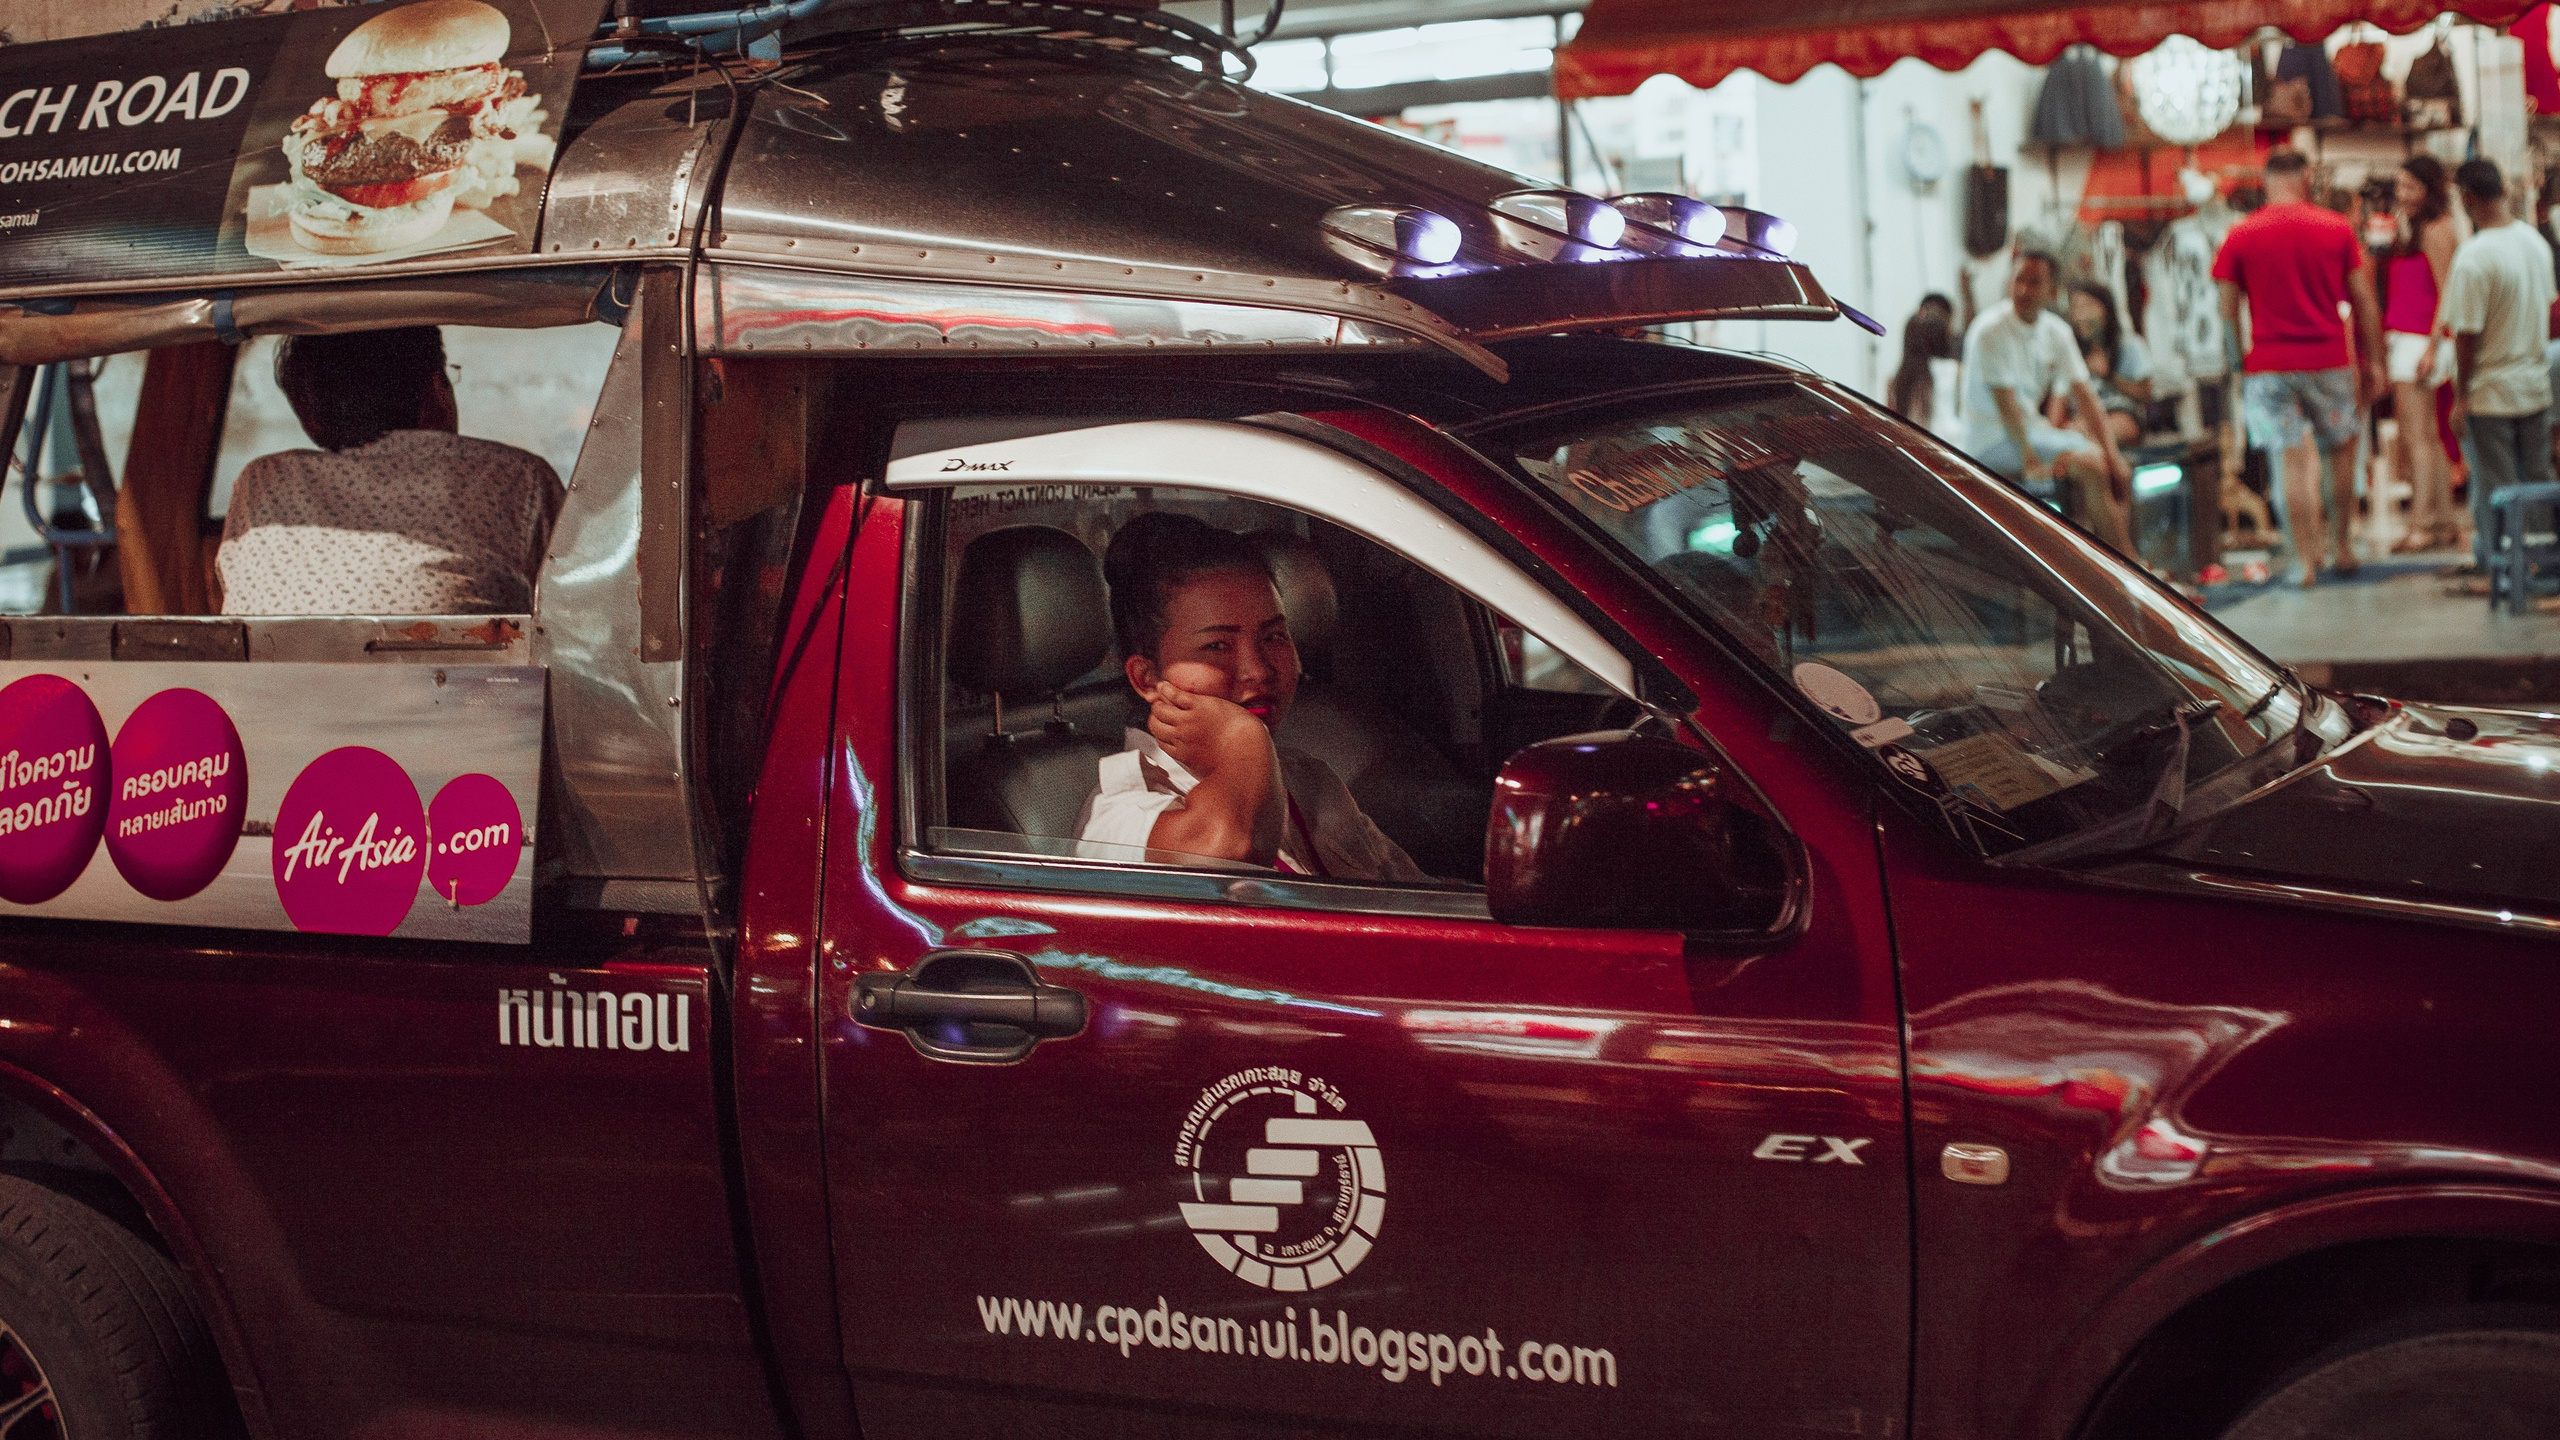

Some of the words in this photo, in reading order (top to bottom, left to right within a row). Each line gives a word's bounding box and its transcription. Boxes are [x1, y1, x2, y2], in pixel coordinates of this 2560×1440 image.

[0, 84, 79, 138] CH
[78, 67, 250, 130] ROAD
[0, 148, 181, 184] OHSAMUI.COM
[122, 752, 229, 801] ครอบคลุม
[119, 794, 228, 838] หลายเส้นทาง
[438, 822, 510, 855] .com
[498, 972, 690, 1053] หน้าทอน
[1752, 1133, 1875, 1166] EX
